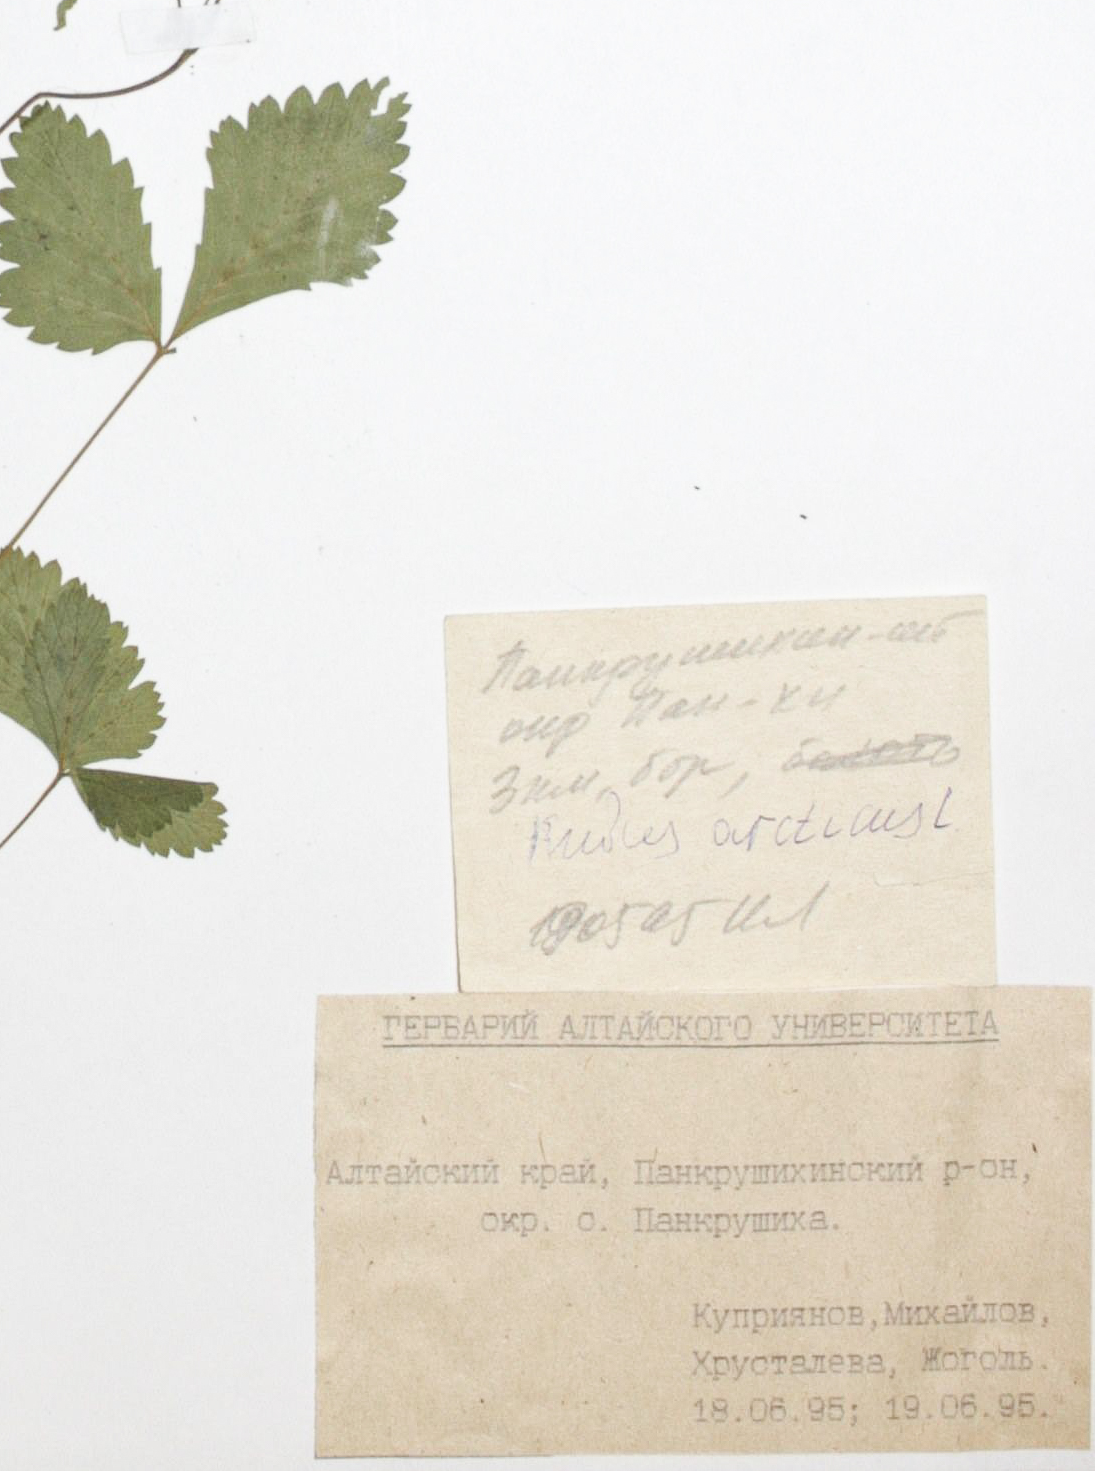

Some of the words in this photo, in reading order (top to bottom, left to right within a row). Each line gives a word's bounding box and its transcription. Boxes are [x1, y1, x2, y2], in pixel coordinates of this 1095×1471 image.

[382, 1009, 539, 1041] ГЕРБАРИЙ
[559, 1010, 752, 1041] АЛТАЙСКОГО
[771, 1009, 999, 1039] УНИВЕРСИТЕТА
[325, 1157, 499, 1186] Алтайский
[520, 1158, 609, 1190] край,
[633, 1154, 924, 1191] Панкрушихинский
[480, 1211, 550, 1238] окр.
[633, 1207, 840, 1239] Панкрушиха.
[691, 1350, 897, 1381] Хрусталева,
[920, 1346, 1049, 1372] Жоголь.
[694, 1396, 859, 1427] 18.06.95;
[885, 1392, 1049, 1421] 19.06.95.
